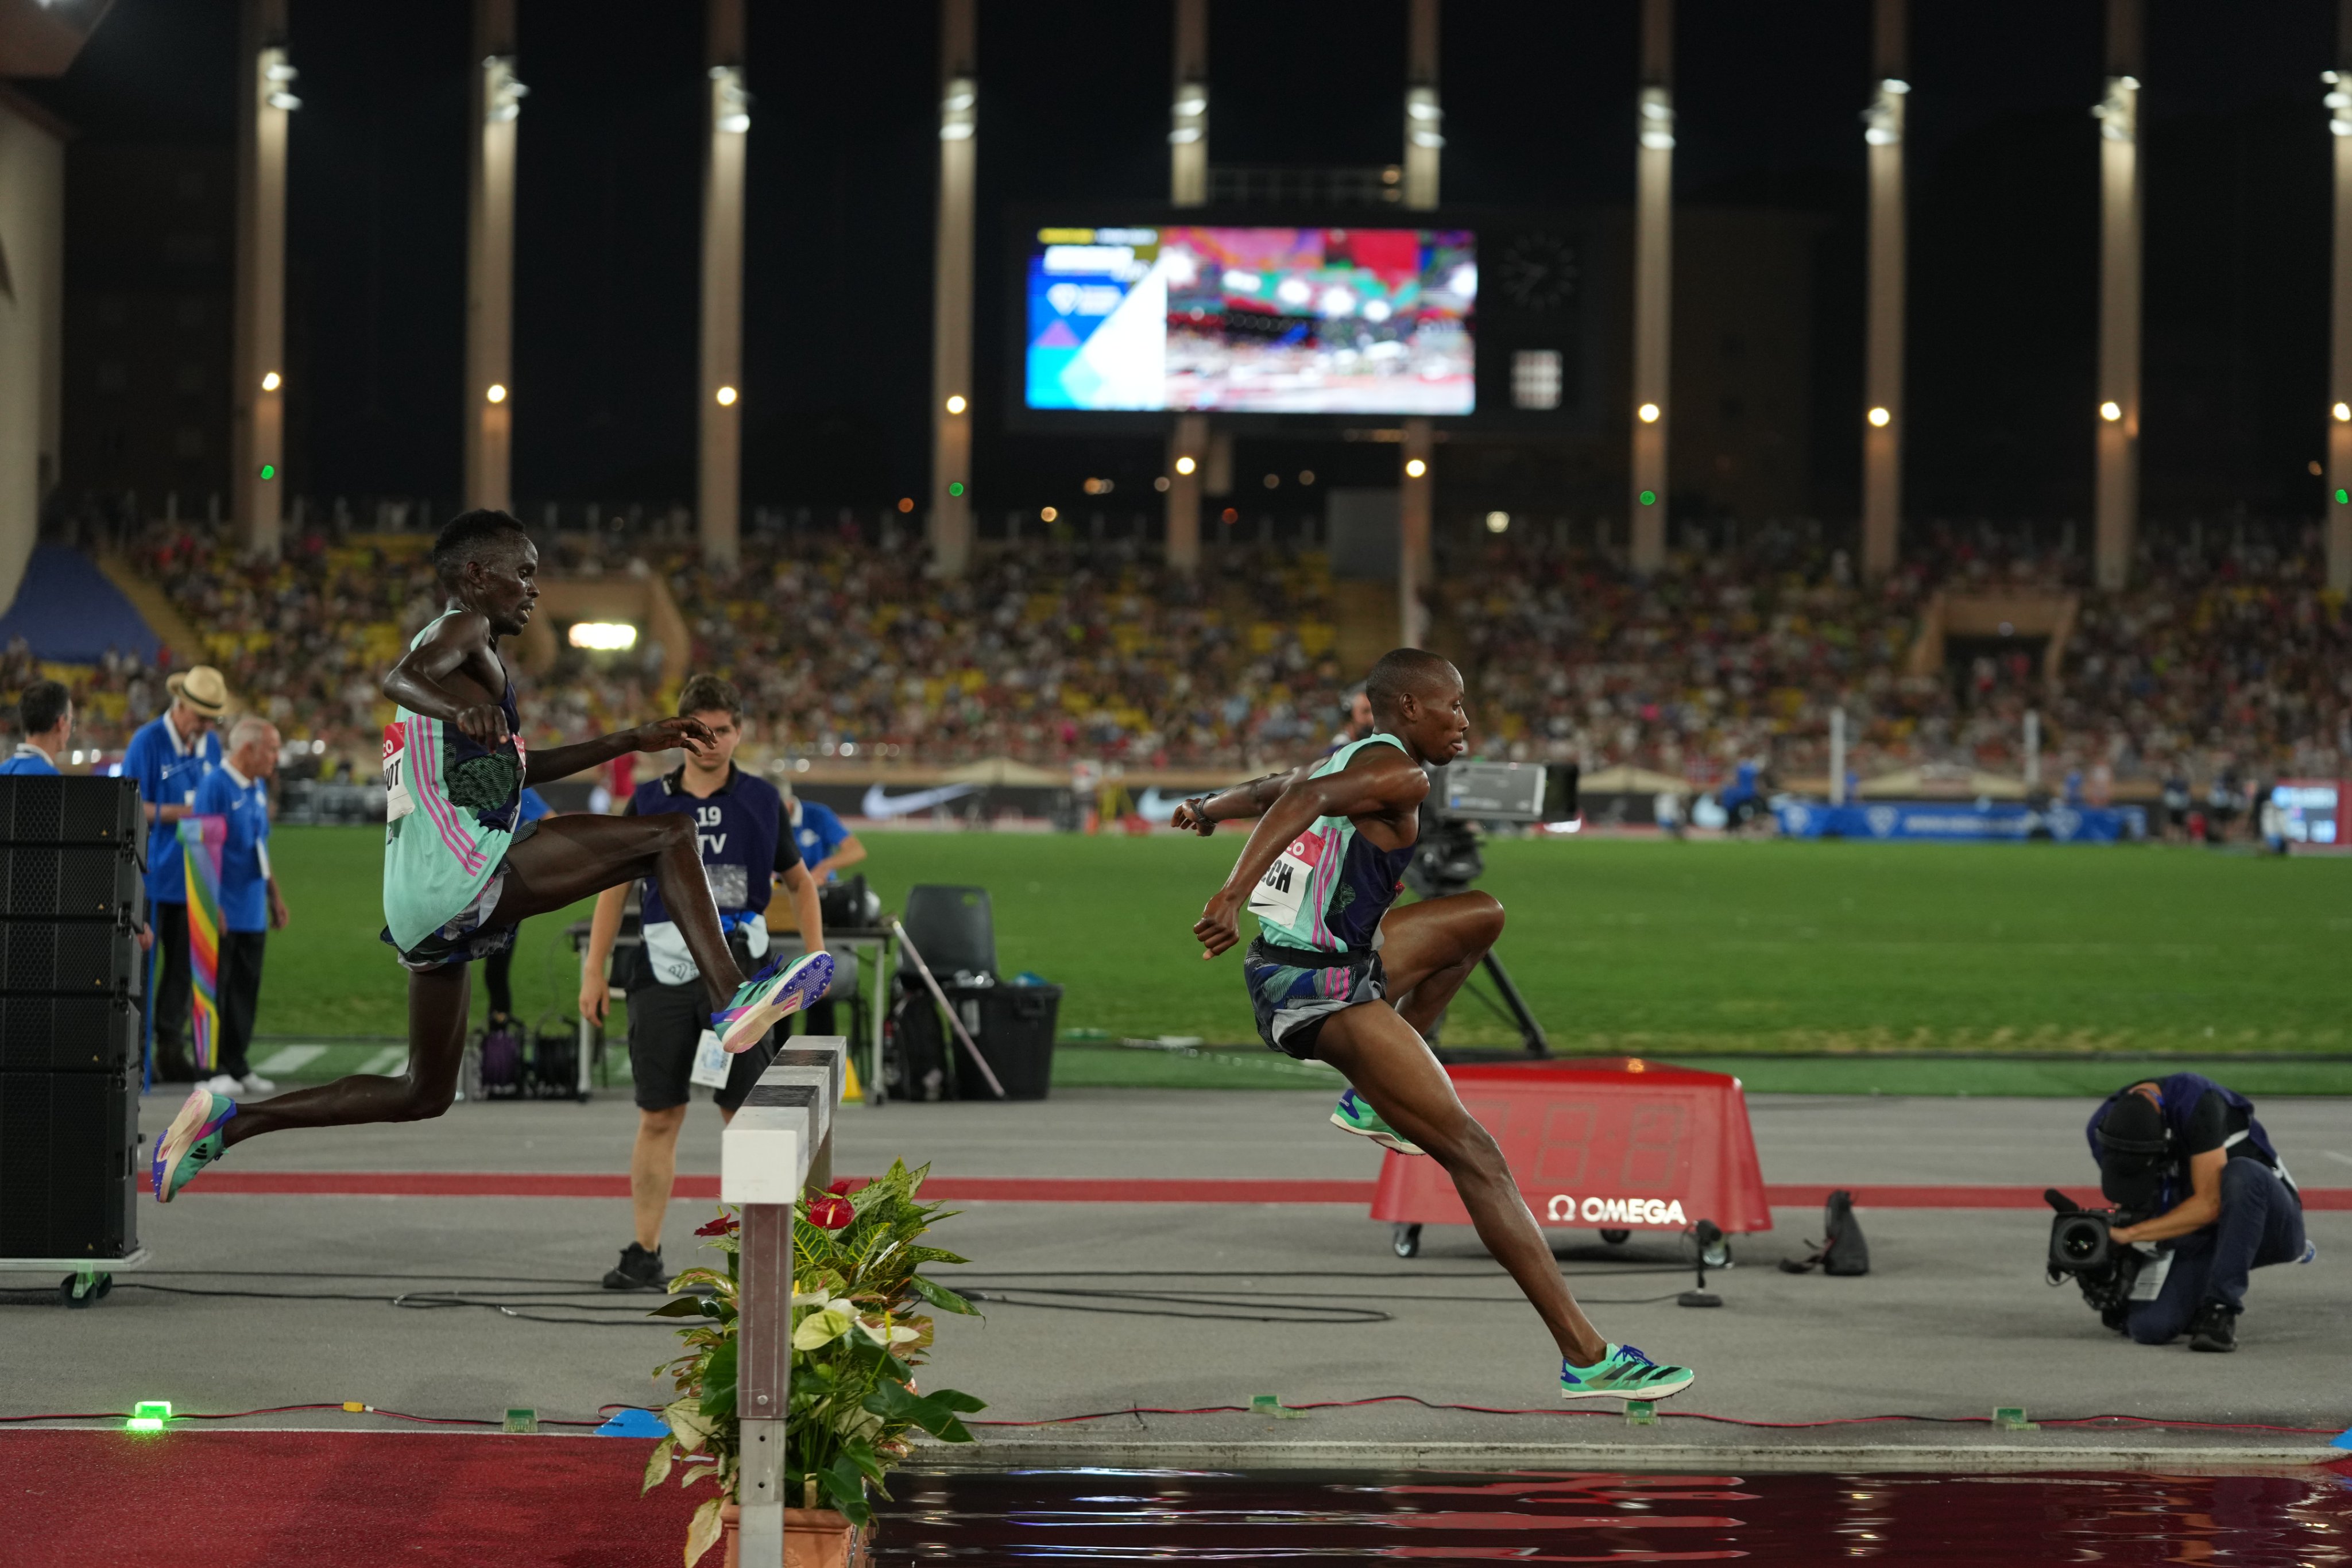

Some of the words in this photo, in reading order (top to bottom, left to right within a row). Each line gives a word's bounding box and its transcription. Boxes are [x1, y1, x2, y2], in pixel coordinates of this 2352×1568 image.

[697, 806, 722, 827] 19
[698, 833, 727, 854] TV
[1260, 859, 1294, 893] CH
[1581, 1197, 1687, 1225] OMEGA
